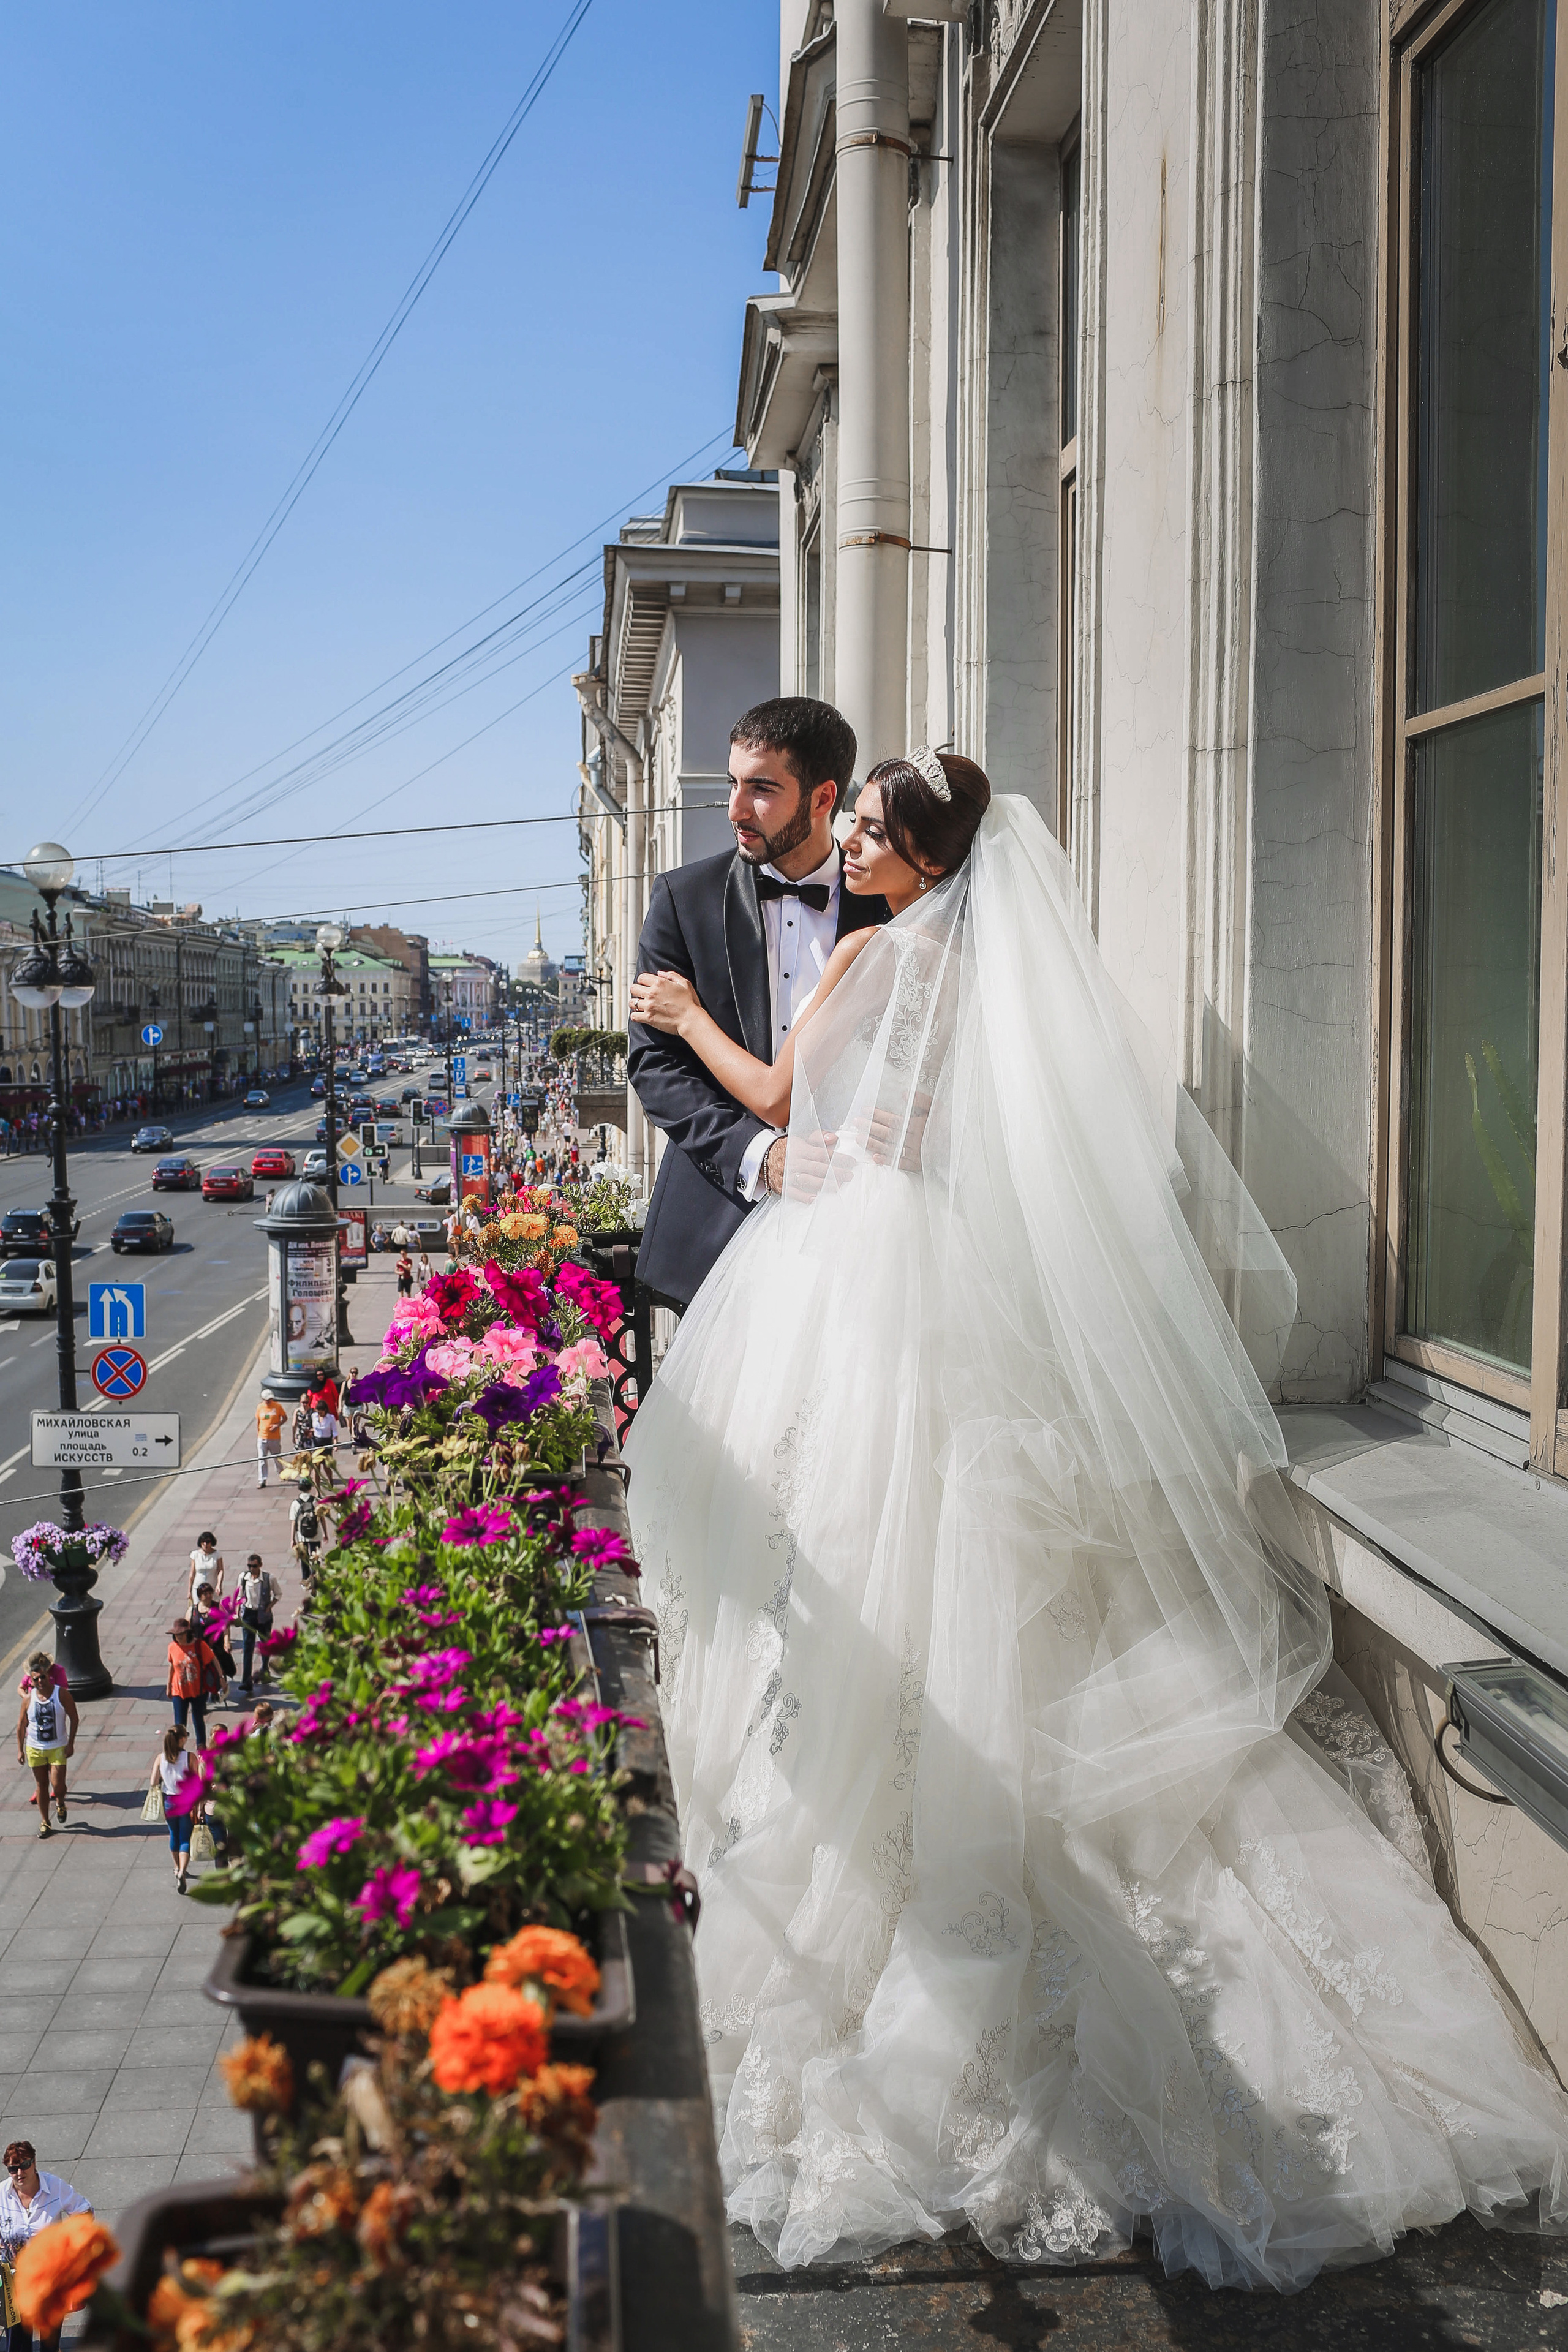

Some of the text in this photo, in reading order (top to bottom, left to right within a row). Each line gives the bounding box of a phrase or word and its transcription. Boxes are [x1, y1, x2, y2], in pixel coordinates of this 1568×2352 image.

[37, 1417, 131, 1428] МИХАЙЛОВСКАЯ
[68, 1430, 99, 1439] улица
[132, 1447, 148, 1457] 0.2
[54, 1453, 113, 1462] ИСКУССТВ
